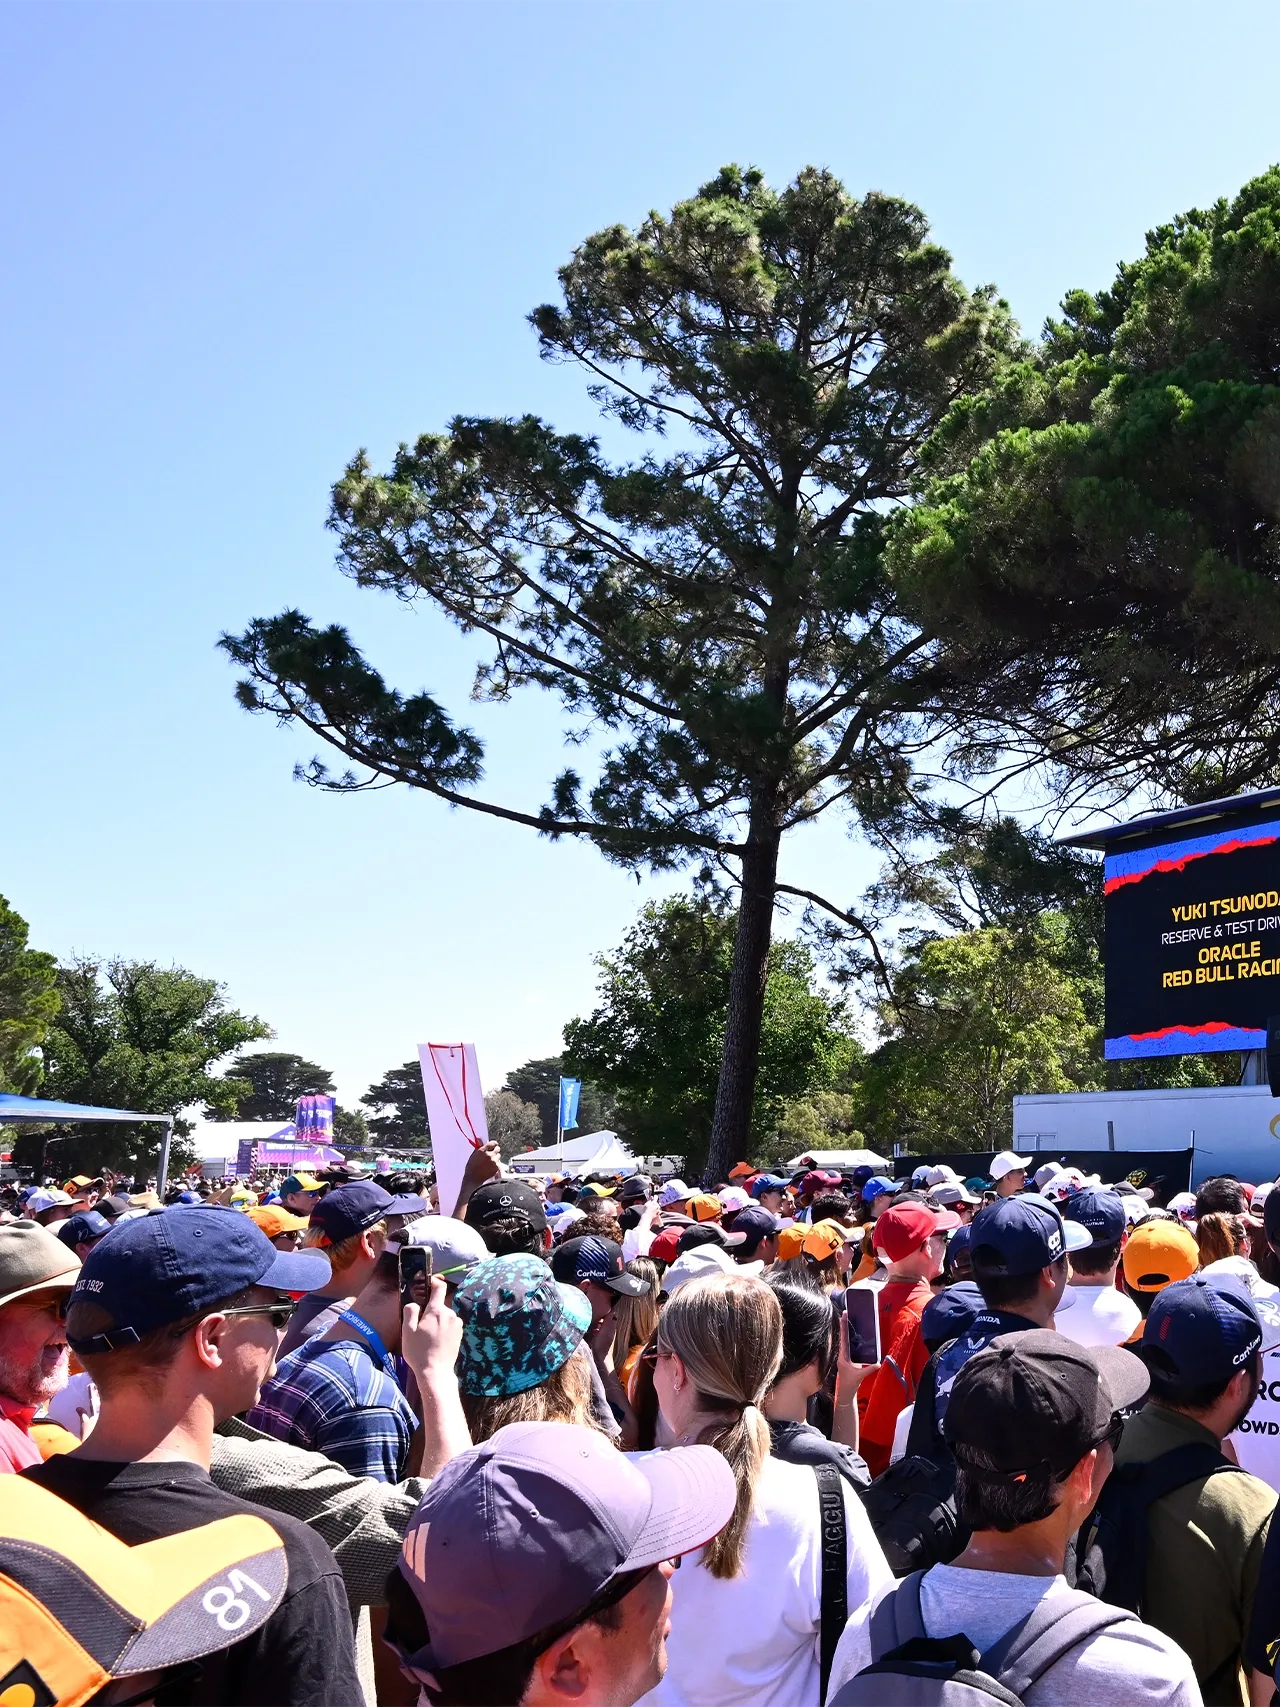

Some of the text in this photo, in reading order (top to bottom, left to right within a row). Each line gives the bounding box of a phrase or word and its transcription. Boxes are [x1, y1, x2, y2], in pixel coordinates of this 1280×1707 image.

[1171, 902, 1206, 922] YUKI
[1161, 926, 1211, 945] RESERVE
[1213, 924, 1223, 938] &
[1224, 919, 1255, 935] TEST
[1198, 940, 1261, 964] ORACLE
[1162, 970, 1193, 988] RED
[1195, 964, 1235, 984] BULL
[576, 1269, 606, 1278] CarNext
[616, 1256, 623, 1271] 1
[86, 1279, 105, 1294] 1932
[202, 1568, 272, 1631] 81
